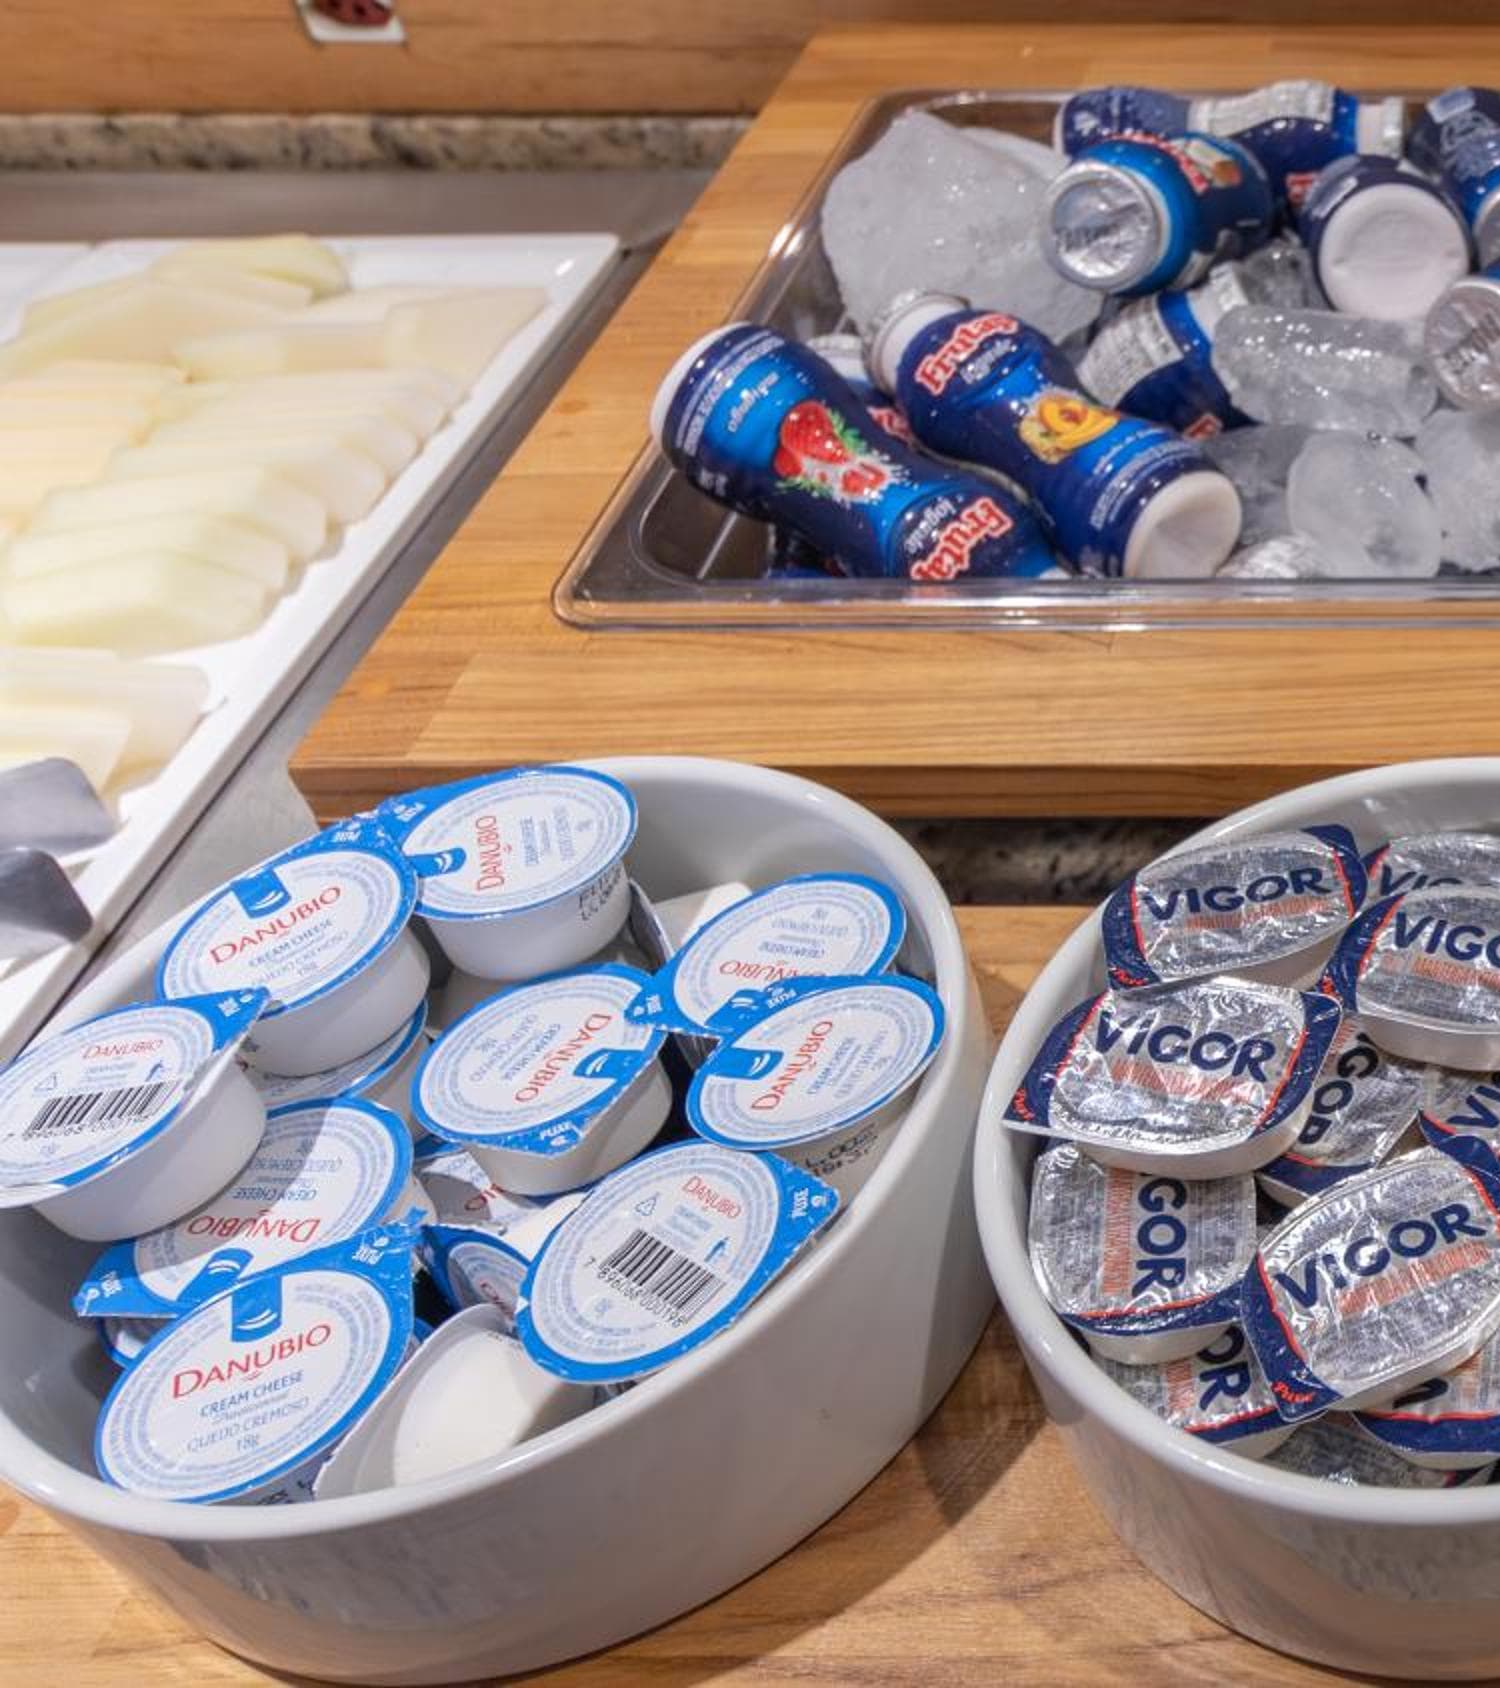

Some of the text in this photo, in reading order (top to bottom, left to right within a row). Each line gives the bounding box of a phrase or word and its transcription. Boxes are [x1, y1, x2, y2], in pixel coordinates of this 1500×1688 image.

[915, 313, 1018, 396] Frutap
[475, 815, 505, 892] DANUBIO
[209, 886, 342, 966] DANUBIO
[1141, 867, 1332, 920] VIGOR
[83, 1039, 164, 1059] DANUBIO
[514, 1012, 613, 1102] DANUBIO
[751, 1020, 834, 1111] DANUBIO
[1095, 1010, 1276, 1083] VIGOR
[187, 1214, 321, 1243] DANUBIO
[681, 1175, 742, 1220] DANUBIO
[1131, 1175, 1188, 1299] GOR
[1274, 1203, 1486, 1309] VIGOR
[170, 1323, 332, 1400] DANUBIO
[200, 1391, 250, 1419] CREAM
[251, 1370, 305, 1399] CHEESE
